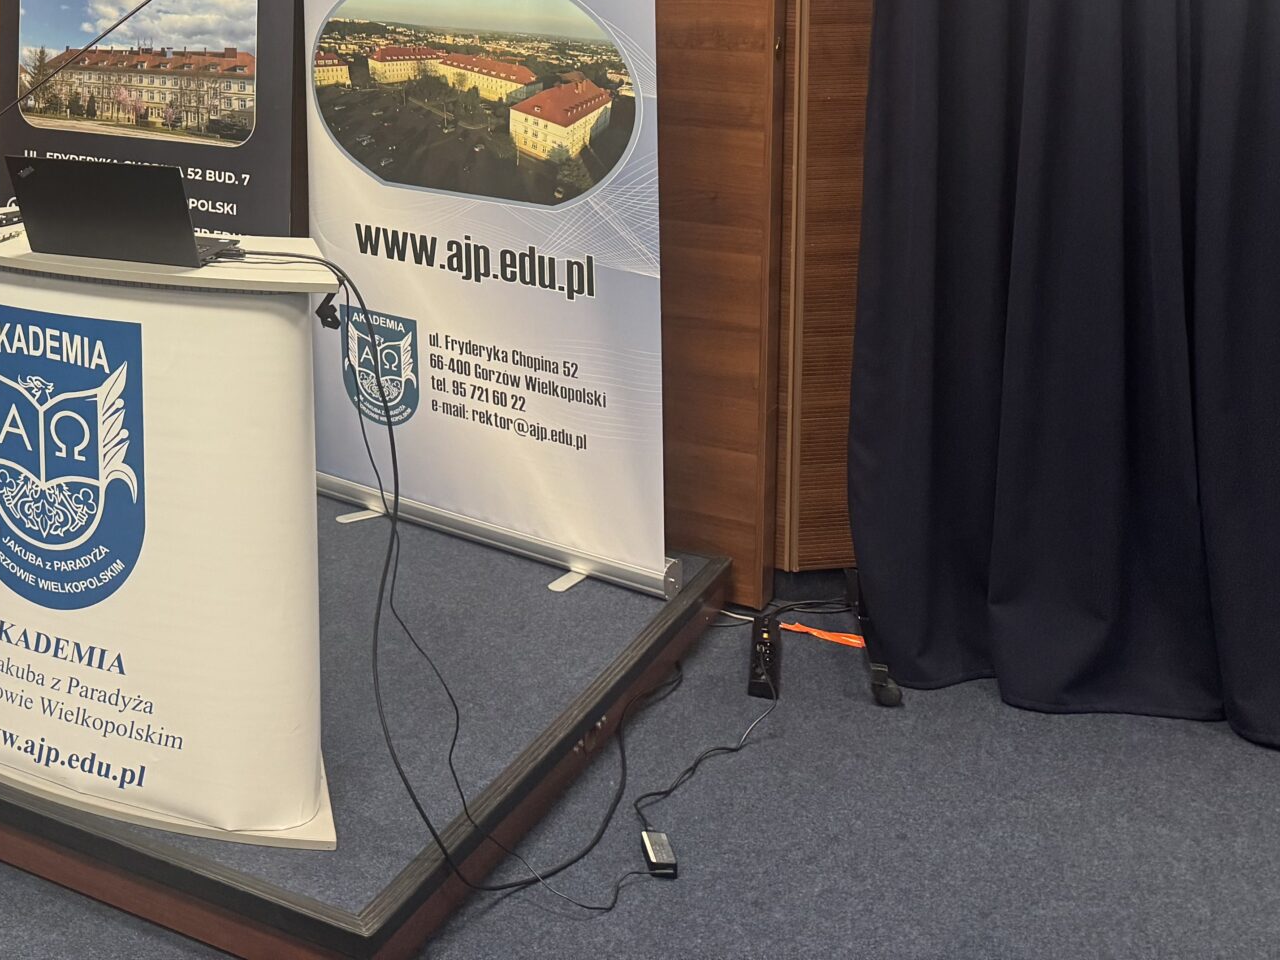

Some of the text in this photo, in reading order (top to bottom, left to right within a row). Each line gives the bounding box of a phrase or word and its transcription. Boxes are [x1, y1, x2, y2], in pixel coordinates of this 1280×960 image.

[186, 167, 251, 186] 52 BUD. 7
[187, 198, 237, 216] POLSKI
[355, 222, 596, 301] www.ajp.edu.pl
[428, 332, 579, 379] ul. Fryderyka Chopina 52
[429, 354, 607, 409] 66-400 Gorzów Wielkopolski
[431, 374, 526, 413] tel. 95 721 60 22
[431, 398, 588, 451] e-mail: rektor@ajp.edu.pl
[2, 534, 44, 570] JAKUBA
[45, 561, 53, 571] z
[53, 544, 111, 573] PARADYŻA
[37, 559, 127, 594] WIELKOPOLSKIM
[50, 677, 61, 692] z
[66, 676, 155, 716] Paradyża
[39, 696, 185, 751] Wielkopolskim
